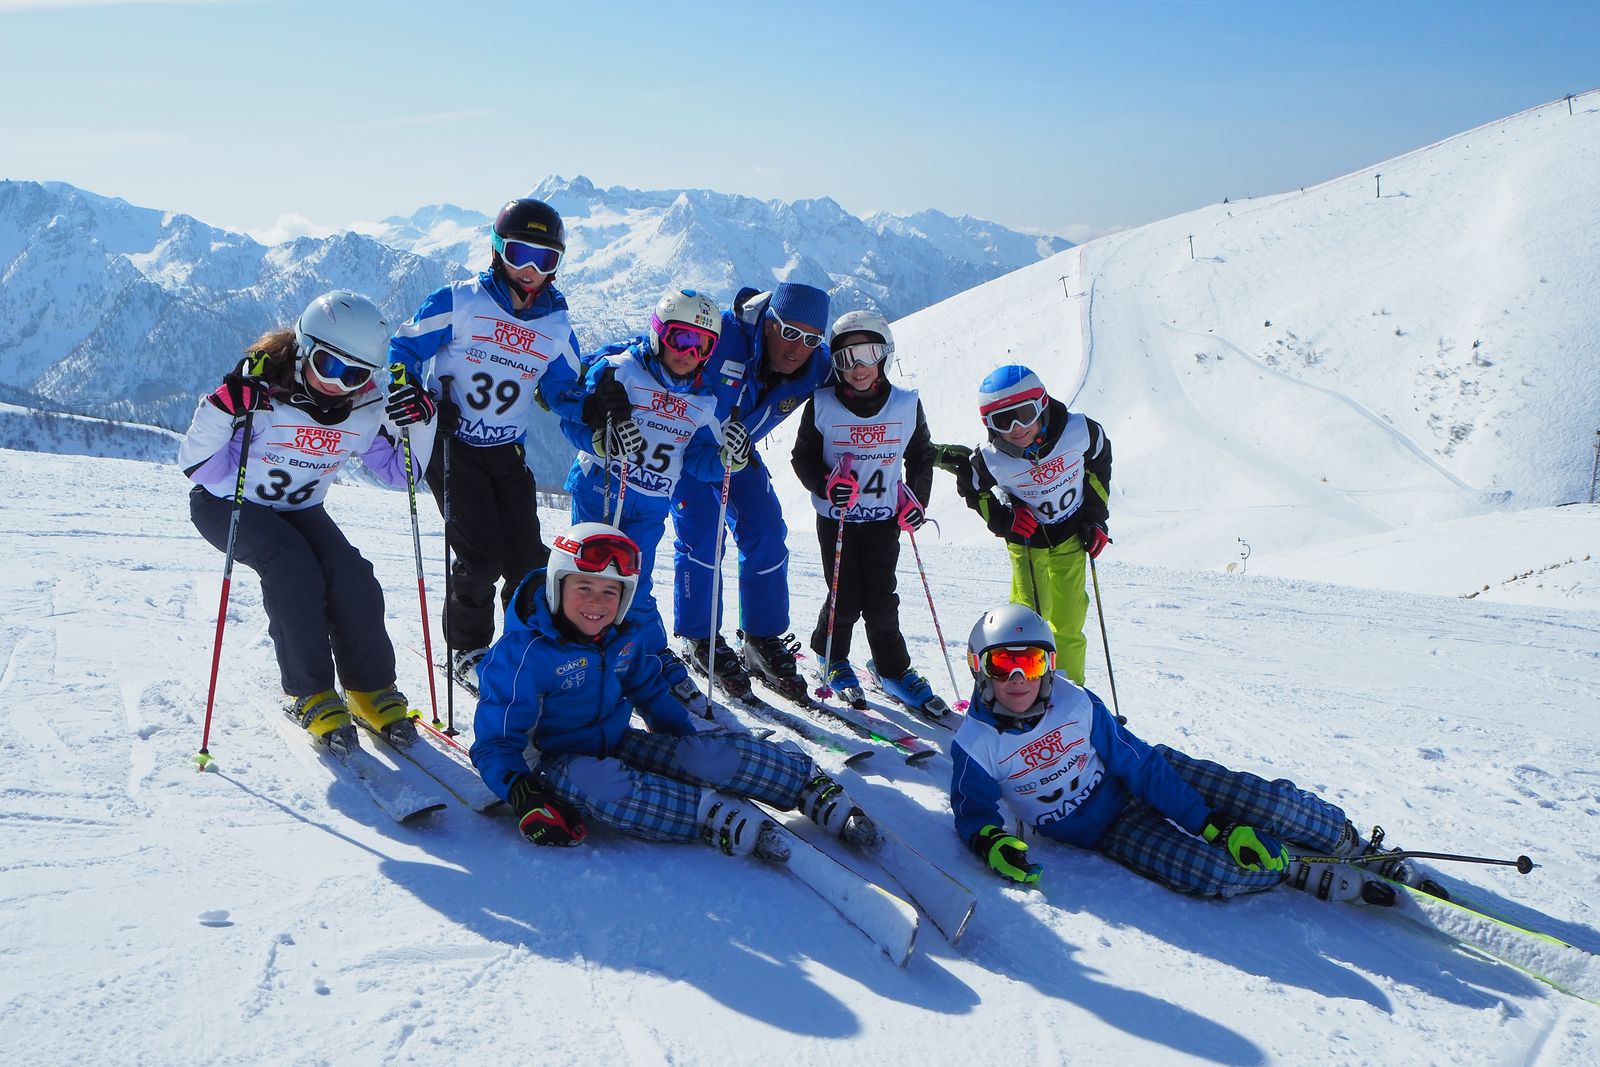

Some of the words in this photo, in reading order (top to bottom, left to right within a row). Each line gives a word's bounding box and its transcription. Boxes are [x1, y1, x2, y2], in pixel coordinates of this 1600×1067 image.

[494, 328, 535, 351] SPORT
[496, 321, 536, 339] PERICO
[466, 371, 521, 416] 39
[652, 392, 688, 408] PERICO
[651, 399, 688, 418] SPORT
[296, 428, 342, 440] PERICO
[850, 425, 887, 433] PERICO
[850, 432, 886, 444] SPORT
[294, 435, 341, 453] SPORT
[402, 437, 411, 473] LEKI
[609, 459, 673, 494] CAN2
[1029, 457, 1064, 476] PERICO
[1033, 461, 1065, 483] SPORT
[236, 466, 246, 505] LEKI
[255, 468, 321, 505] 36
[722, 465, 731, 504] HEAD
[1037, 488, 1077, 519] 40
[1020, 730, 1061, 757] PERICO
[1024, 737, 1065, 767] SPORT
